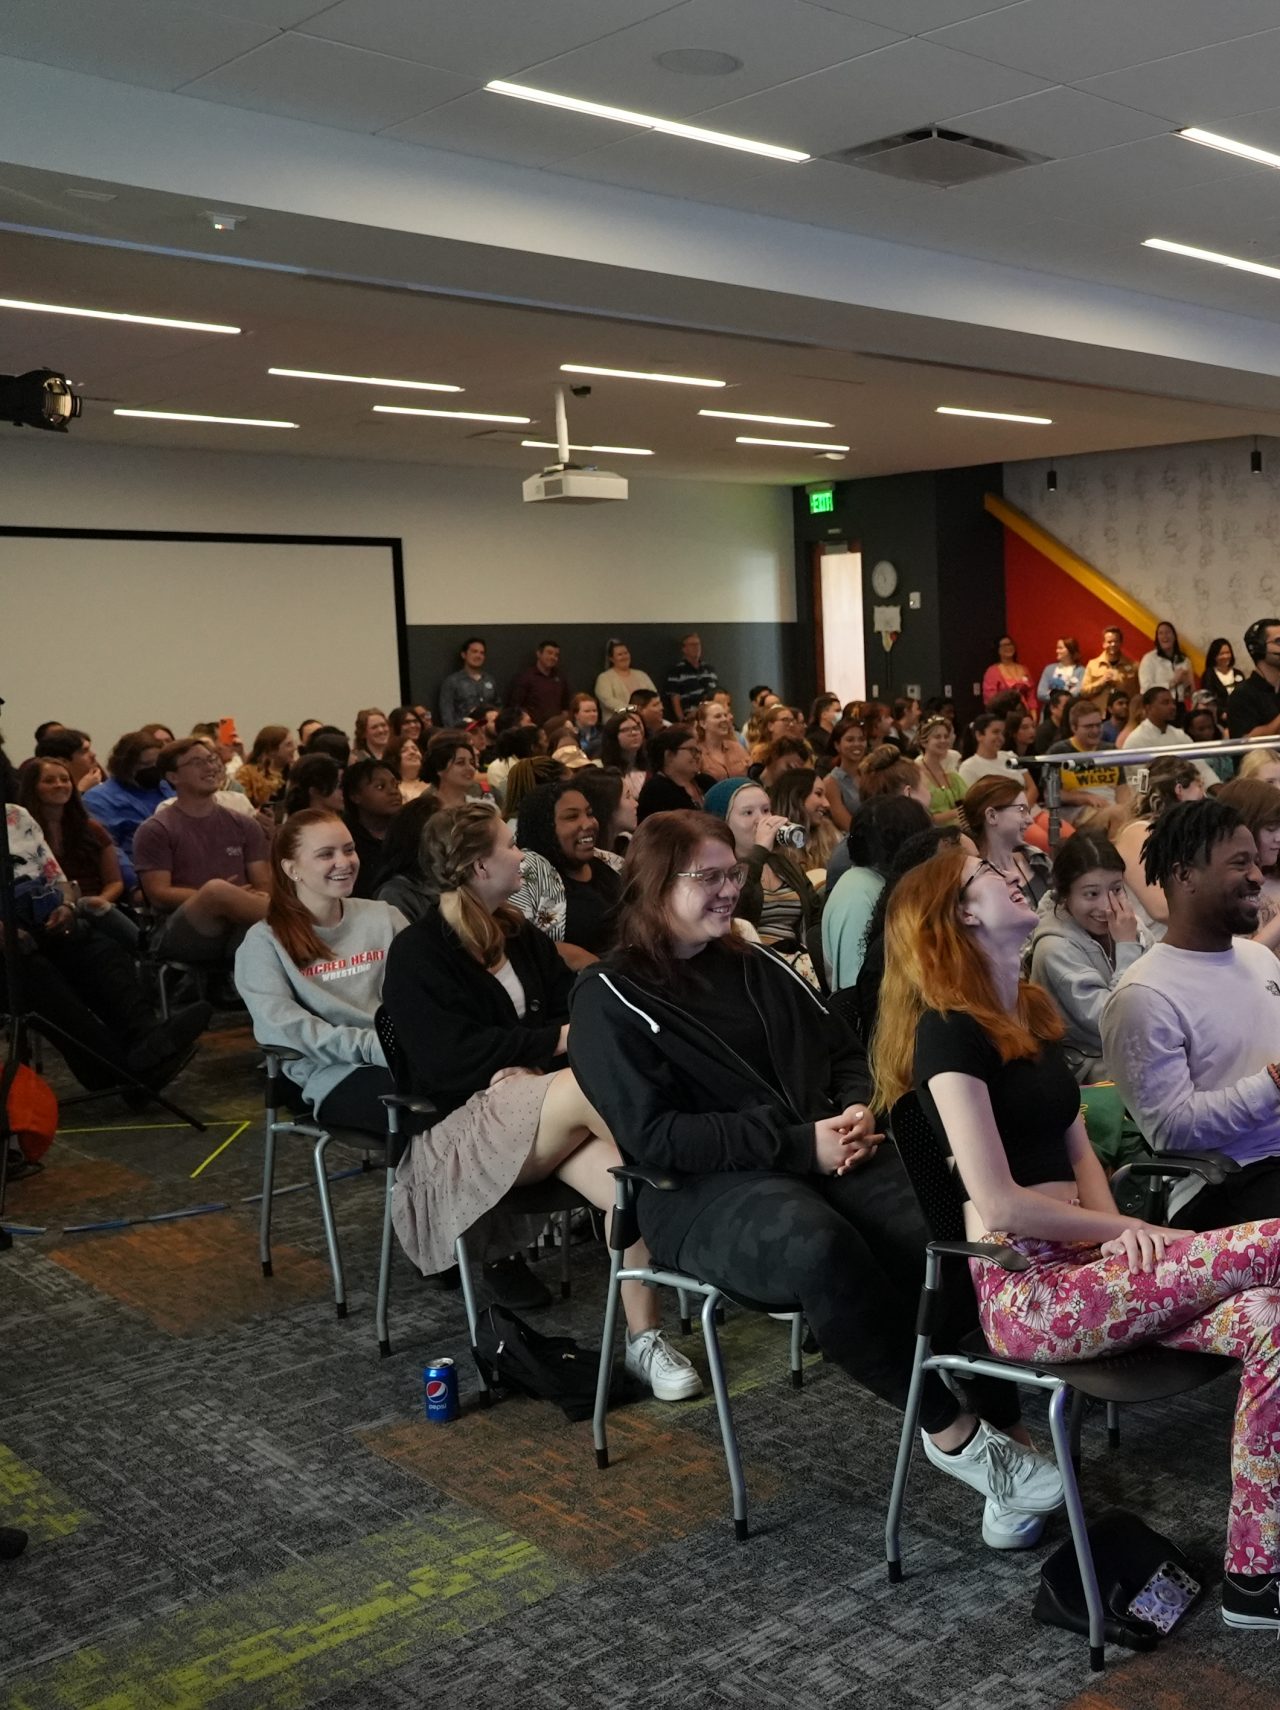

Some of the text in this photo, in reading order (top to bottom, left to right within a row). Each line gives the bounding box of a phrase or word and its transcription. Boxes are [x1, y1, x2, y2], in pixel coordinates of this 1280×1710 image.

[812, 493, 833, 513] EXIT
[1076, 773, 1117, 786] WARS
[351, 950, 385, 965] HEART
[321, 963, 372, 982] WRESTLING
